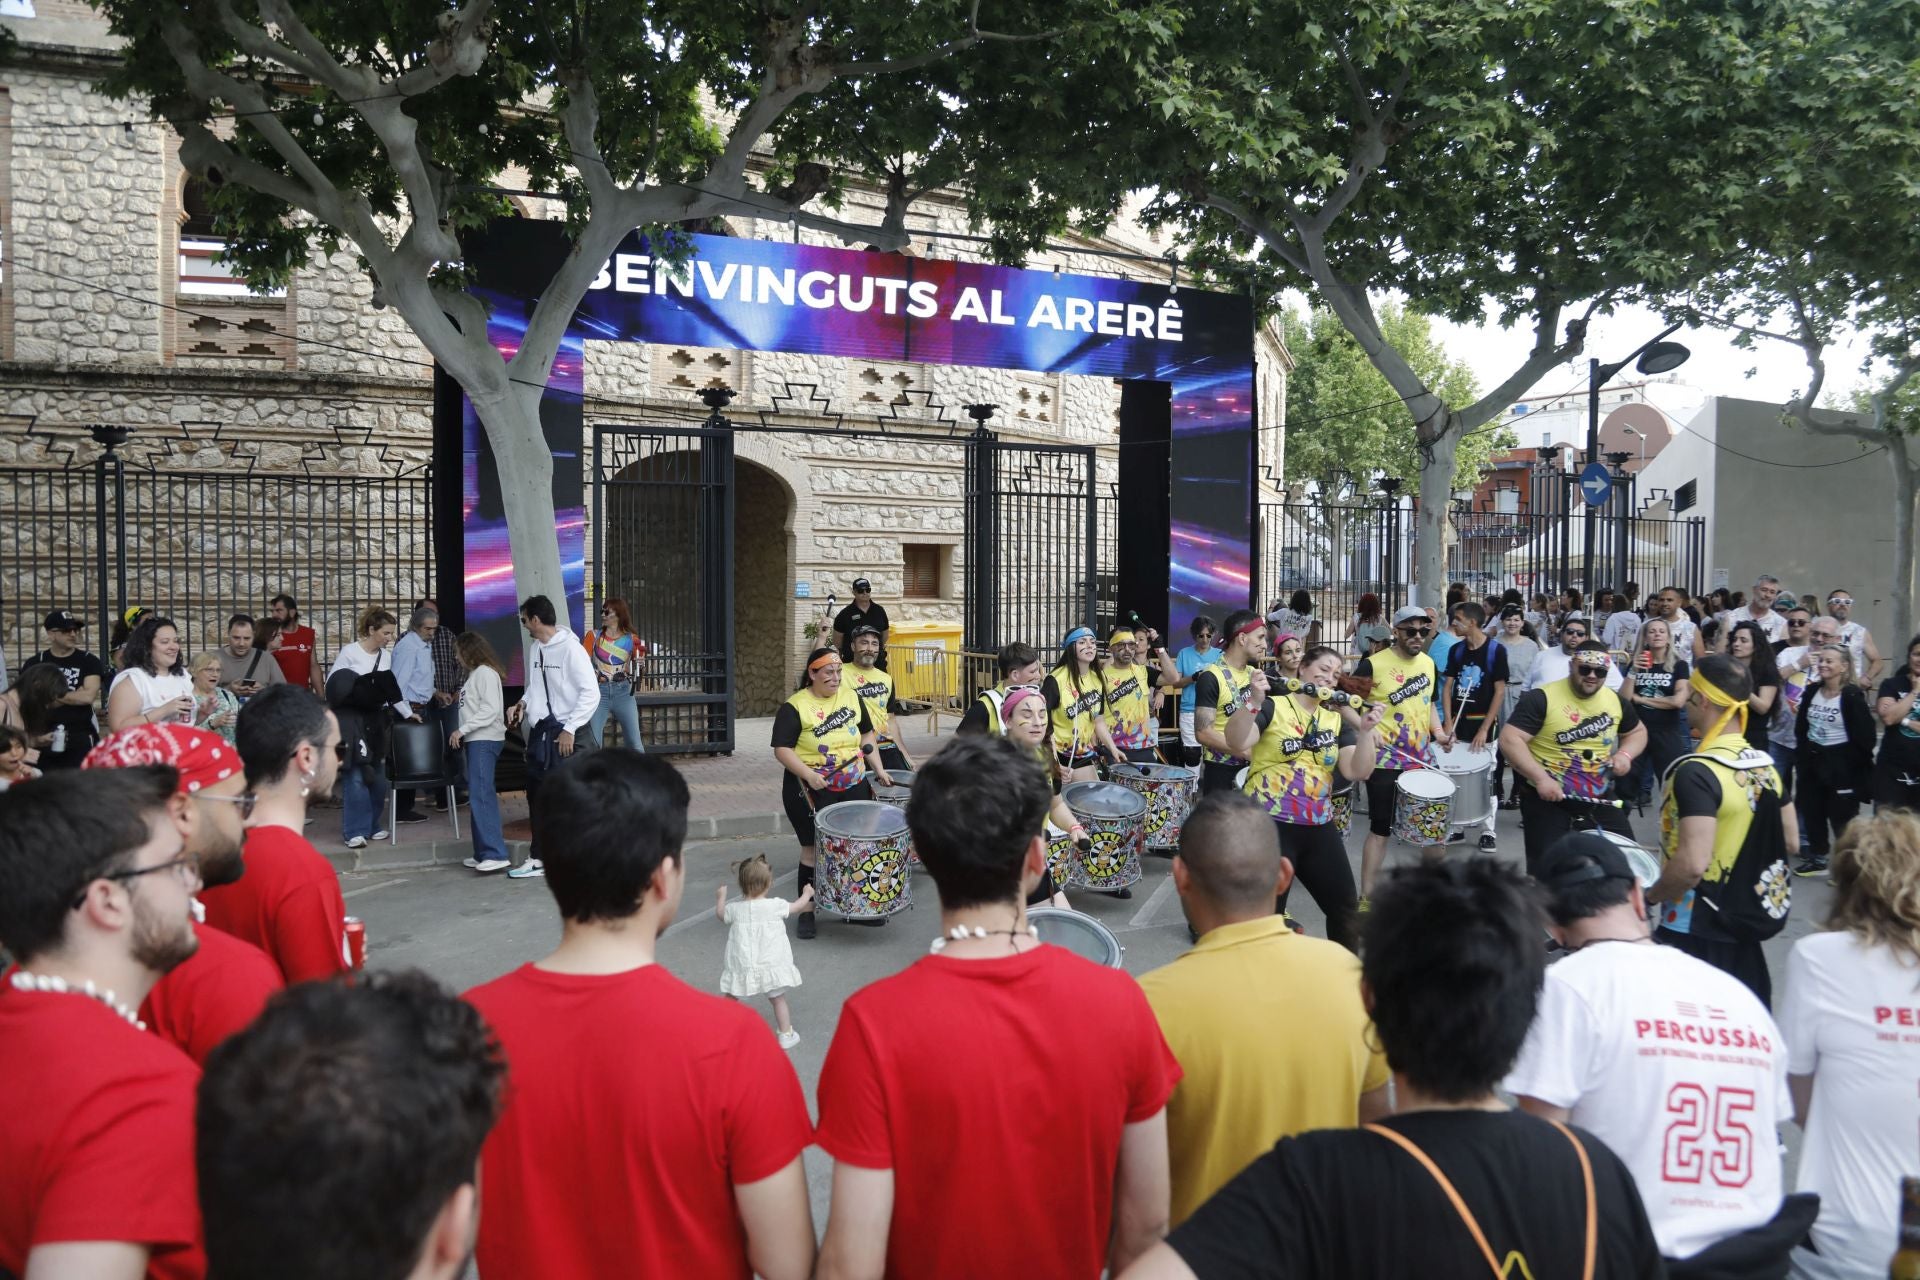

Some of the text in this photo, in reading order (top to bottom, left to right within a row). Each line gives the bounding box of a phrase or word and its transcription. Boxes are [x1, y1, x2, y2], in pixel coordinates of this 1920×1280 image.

[588, 253, 1184, 341] BENVINGUTS AL ARERÊ
[1390, 675, 1429, 703] BATUTRALLA
[1284, 732, 1337, 753] BATALLA
[1557, 714, 1613, 744] BATUTRALLA
[1662, 1082, 1755, 1188] 25
